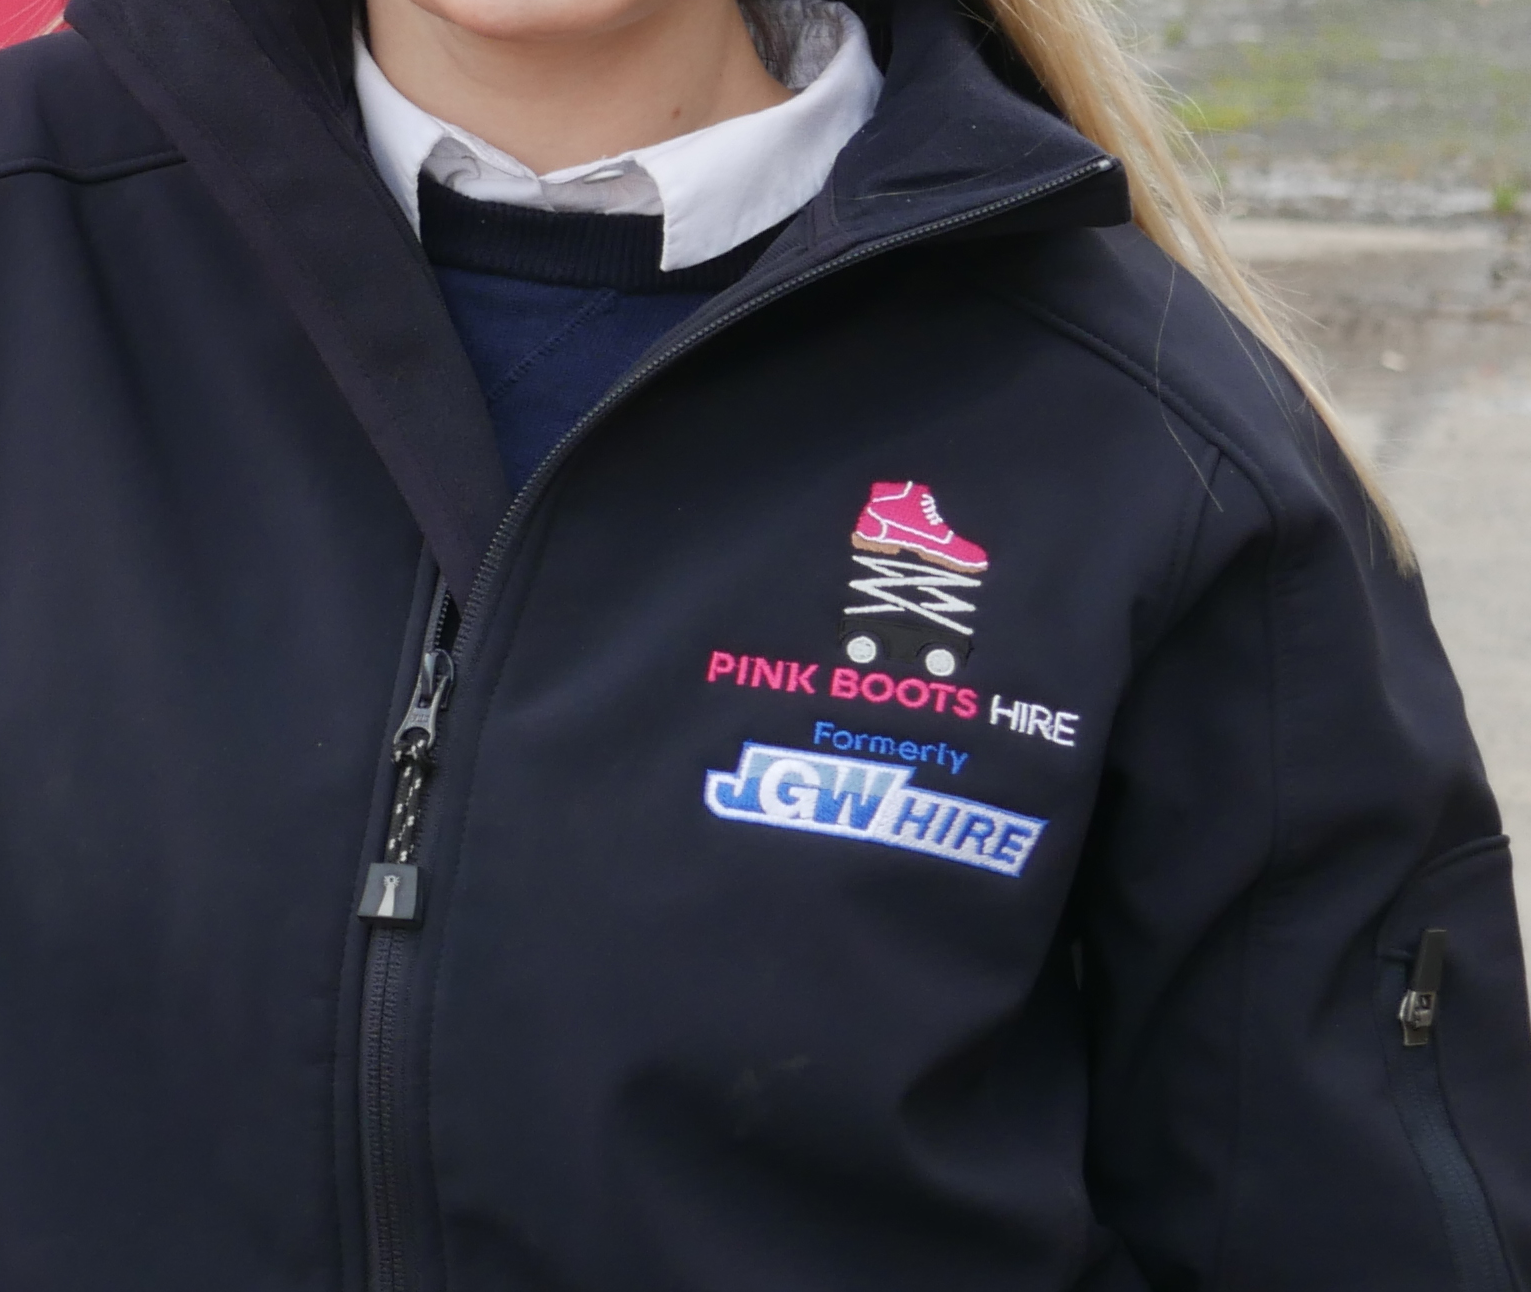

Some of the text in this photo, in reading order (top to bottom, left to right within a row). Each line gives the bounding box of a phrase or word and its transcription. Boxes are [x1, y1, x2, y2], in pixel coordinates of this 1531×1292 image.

[705, 649, 1080, 747] PINK BOOTS HIRE
[813, 720, 970, 775] Formerly
[890, 795, 1035, 866] HIRE
